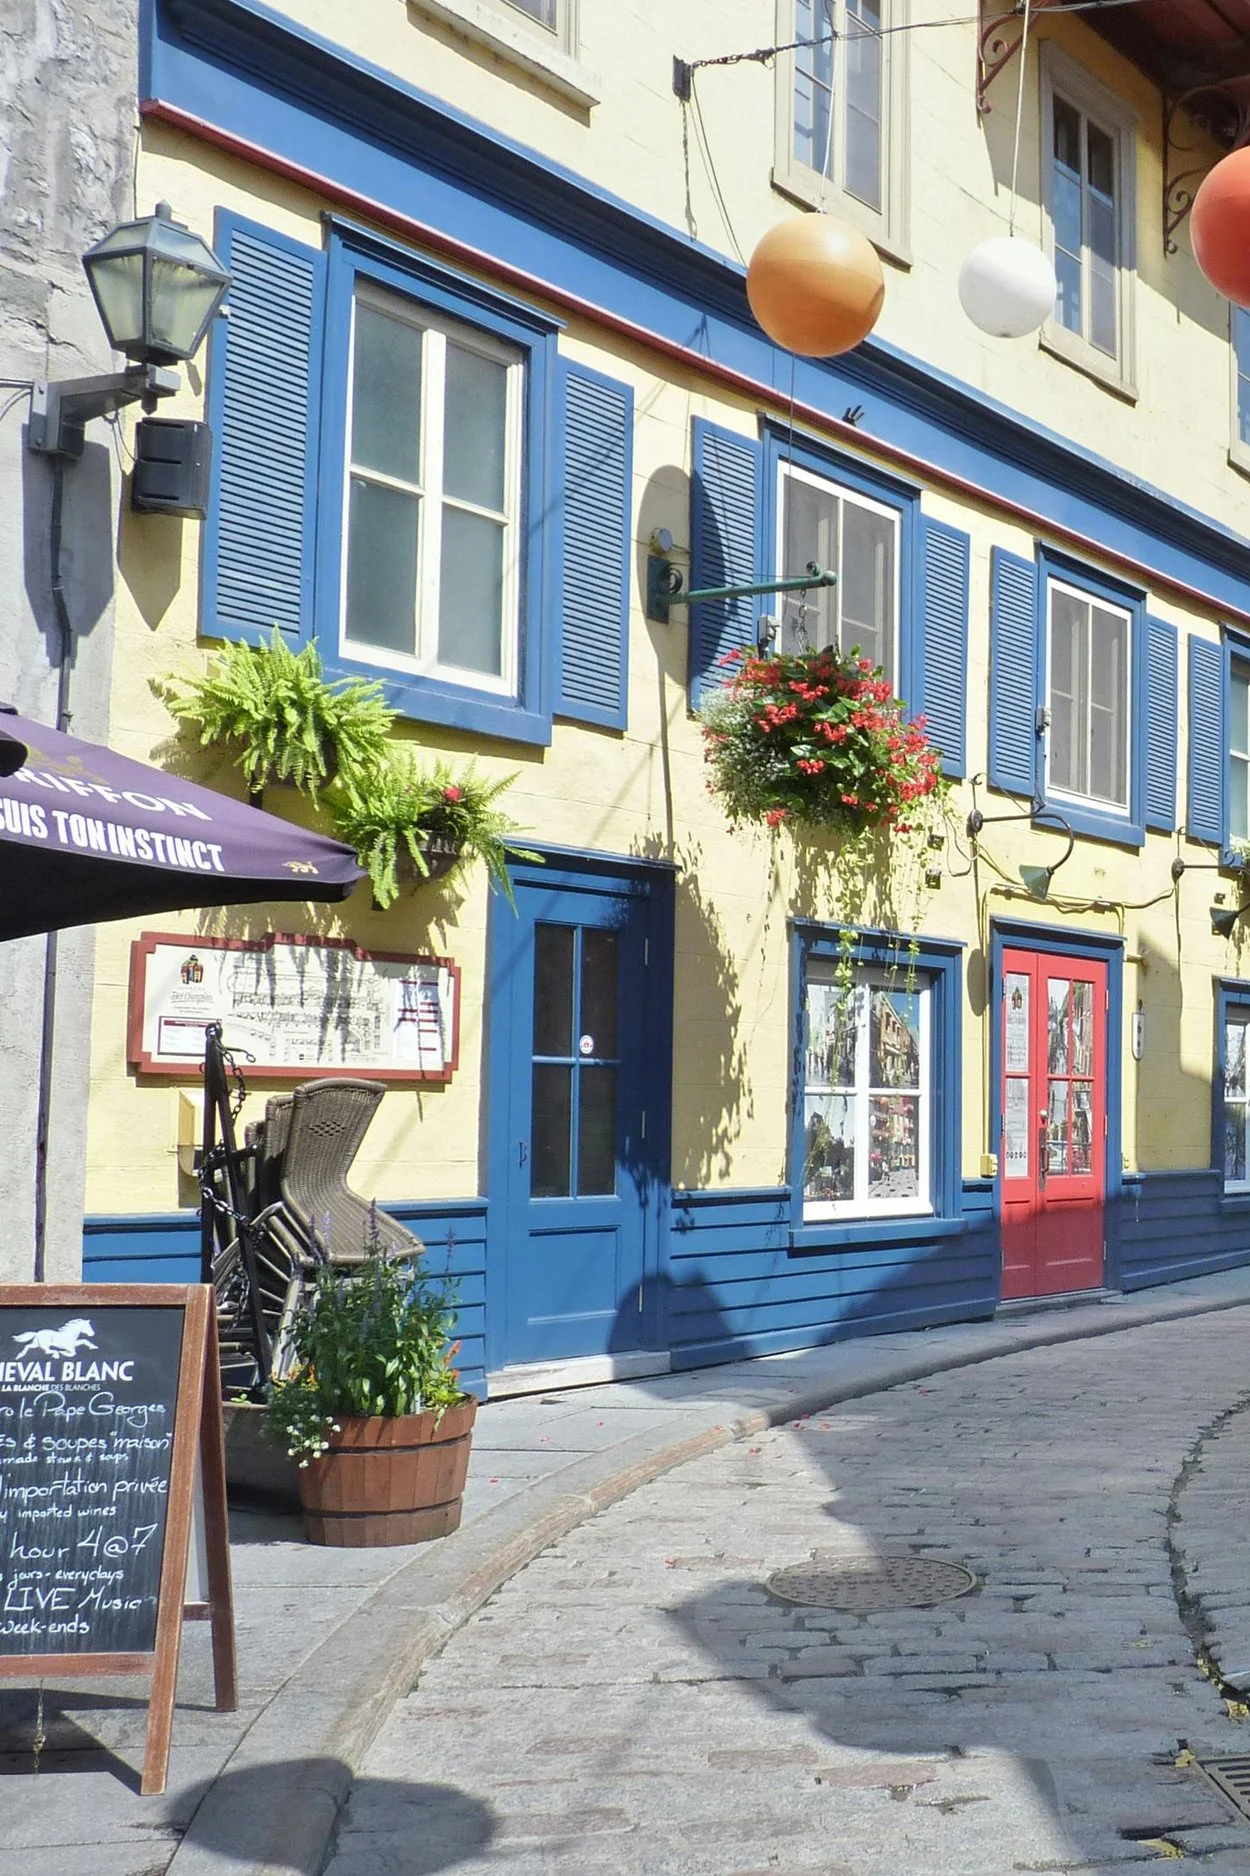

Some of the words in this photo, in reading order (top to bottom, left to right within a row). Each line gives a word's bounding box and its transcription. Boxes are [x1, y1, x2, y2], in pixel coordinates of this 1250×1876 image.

[14, 767, 213, 821] RIFFON
[52, 810, 107, 852] TON
[106, 823, 225, 872] INSTINCT
[62, 1361, 134, 1382] BLANC
[13, 1384, 49, 1392] BLANCHE
[34, 1391, 86, 1422] Pape
[88, 1392, 165, 1428] Georges
[0, 1452, 38, 1465] made
[18, 1502, 72, 1523] imported
[77, 1505, 117, 1516] wines
[10, 1531, 70, 1559] hour
[4, 1586, 76, 1611] LIVE
[78, 1585, 142, 1610] Music
